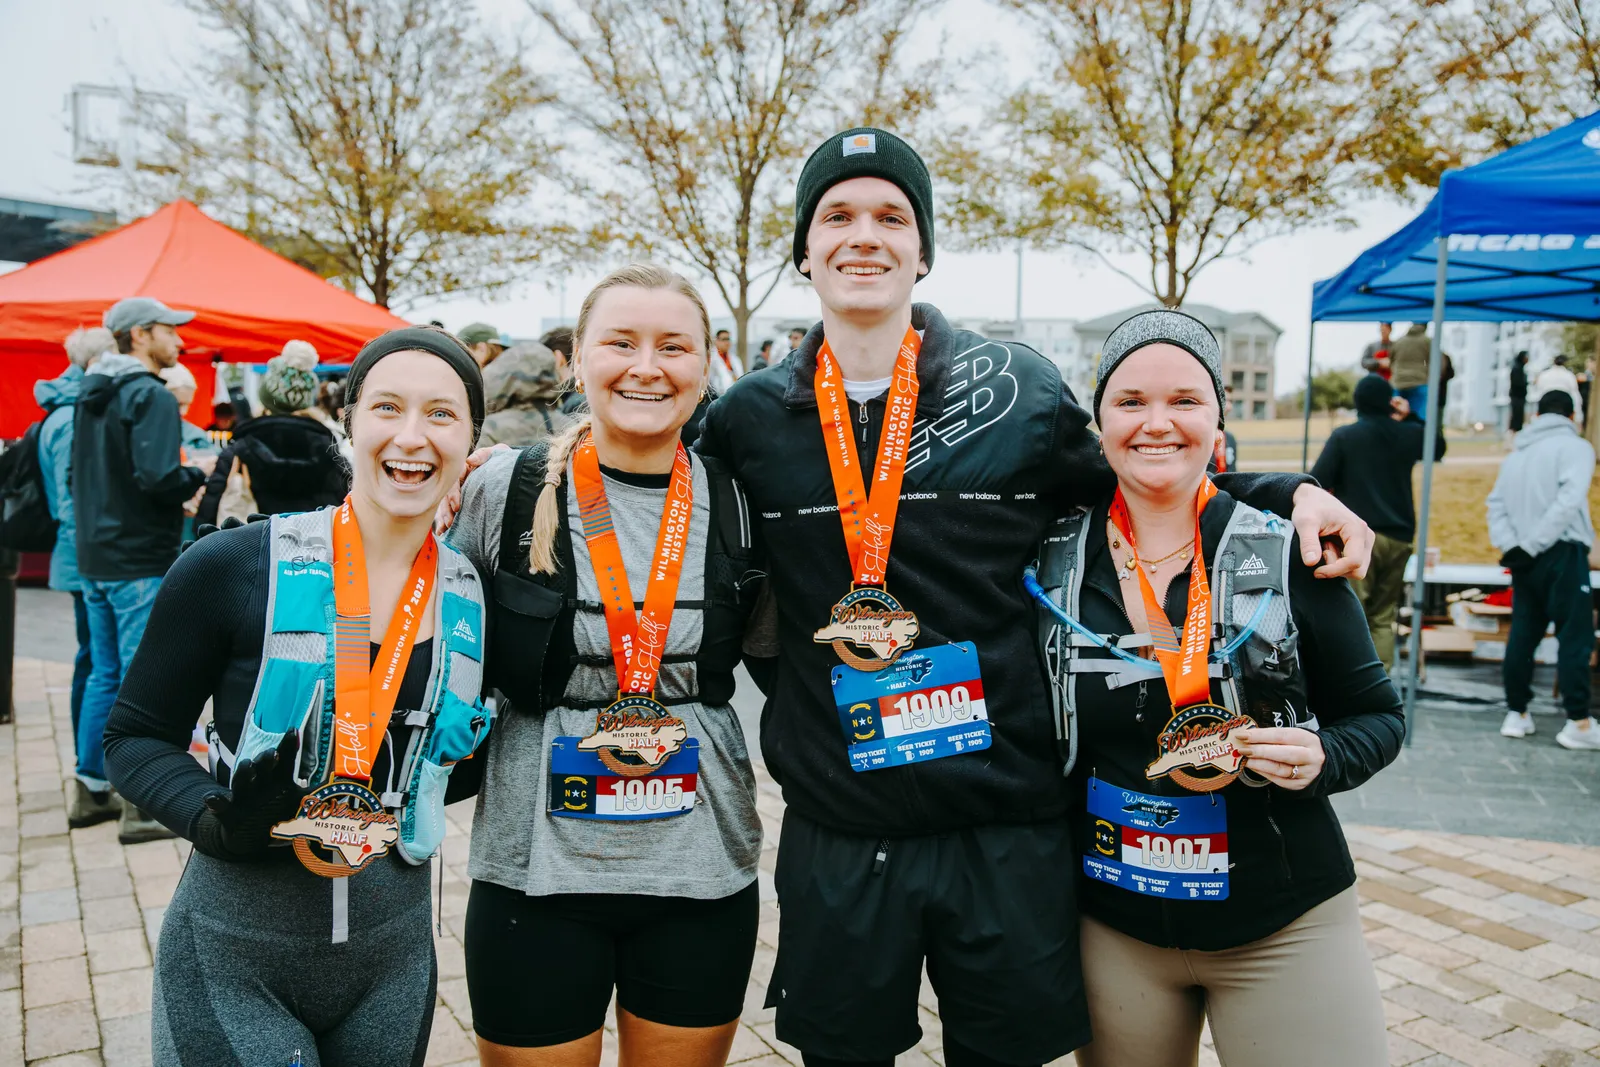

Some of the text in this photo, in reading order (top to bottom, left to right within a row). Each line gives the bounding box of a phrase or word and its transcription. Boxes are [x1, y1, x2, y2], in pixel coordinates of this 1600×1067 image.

[893, 397, 913, 461] HISTORIC
[879, 396, 903, 482] WILMINGTON
[907, 492, 938, 500] balance
[975, 492, 1001, 501] balance
[656, 500, 680, 581] WILMINGTON
[670, 502, 689, 562] HISTORIC
[864, 517, 892, 574] Half
[404, 618, 413, 631] NC
[410, 577, 426, 606] 2025
[831, 604, 914, 627] Wilmington
[637, 615, 668, 672] Half
[861, 631, 892, 643] HALF
[1182, 604, 1200, 676] WILMINGTON
[895, 663, 923, 672] HISTORIC
[890, 681, 907, 690] HALF
[894, 686, 973, 731] 1909
[597, 712, 683, 735] Wilmington
[968, 738, 983, 747] 1909
[1158, 715, 1251, 752] Wilmington
[337, 718, 371, 777] Half
[629, 738, 660, 750] HALF
[919, 748, 934, 756] 1909
[1178, 740, 1218, 756] HISTORIC
[1199, 743, 1234, 763] HALF
[611, 777, 684, 812] 1905
[1121, 791, 1173, 809] Wilmington
[301, 795, 397, 831] Wilmington
[1141, 806, 1169, 815] HISTORIC
[314, 821, 356, 832] HISTORIC
[1134, 818, 1150, 827] HALF
[330, 831, 369, 846] HALF
[1136, 834, 1211, 870] 1907
[1087, 860, 1122, 876] FOOD TICKET
[1105, 873, 1119, 882] 1907
[1131, 873, 1170, 887] BEER TICKET
[1151, 885, 1166, 893] 1907
